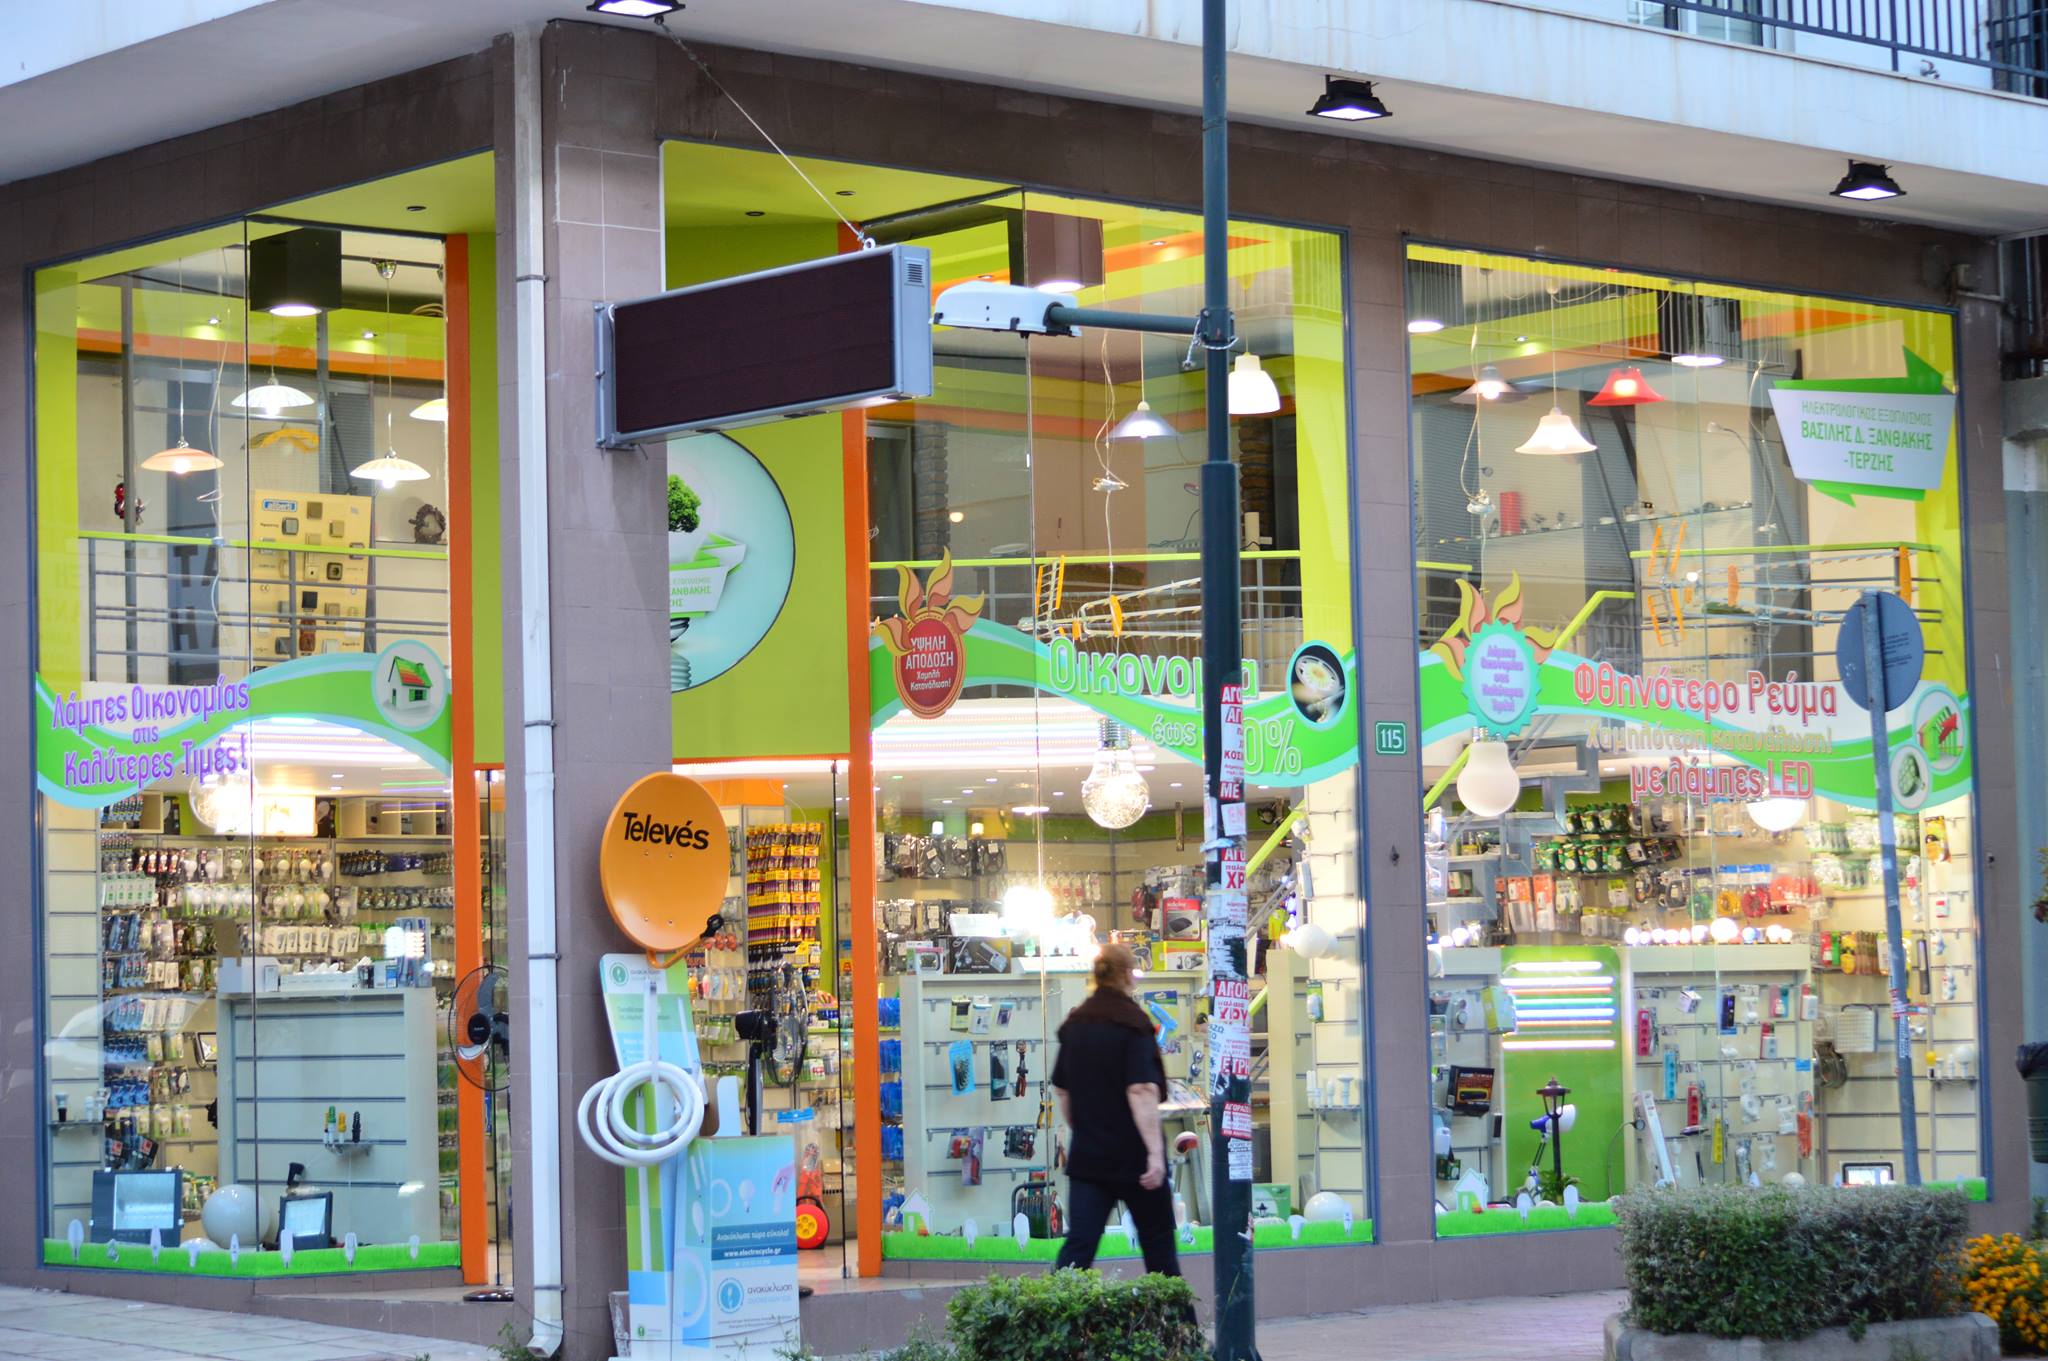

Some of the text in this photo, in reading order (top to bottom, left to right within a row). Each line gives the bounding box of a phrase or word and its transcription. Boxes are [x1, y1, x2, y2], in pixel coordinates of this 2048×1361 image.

[1801, 420, 1852, 442] ΒΑΣΙΛΗΣ
[1867, 427, 1933, 450] ΞΑΝΘΑΚΗΣ
[905, 651, 954, 670] ΑΠΟΔΟΣΗ
[910, 635, 947, 651] ΥΨΗΛΗ
[1050, 636, 1259, 711] Οικονοα
[1573, 661, 1739, 723] Φθηνότερο
[1747, 670, 1837, 725] Ρεύμα
[53, 674, 250, 736] Λάμπες Οικονομίας
[132, 726, 160, 744] στις
[1151, 714, 1198, 747] έως
[1242, 717, 1302, 775] 0%
[1381, 729, 1402, 748] 115
[65, 732, 248, 790] Καλύτερες Τιμές!
[1630, 756, 1813, 807] με λάμπες LED
[624, 812, 710, 850] Televés
